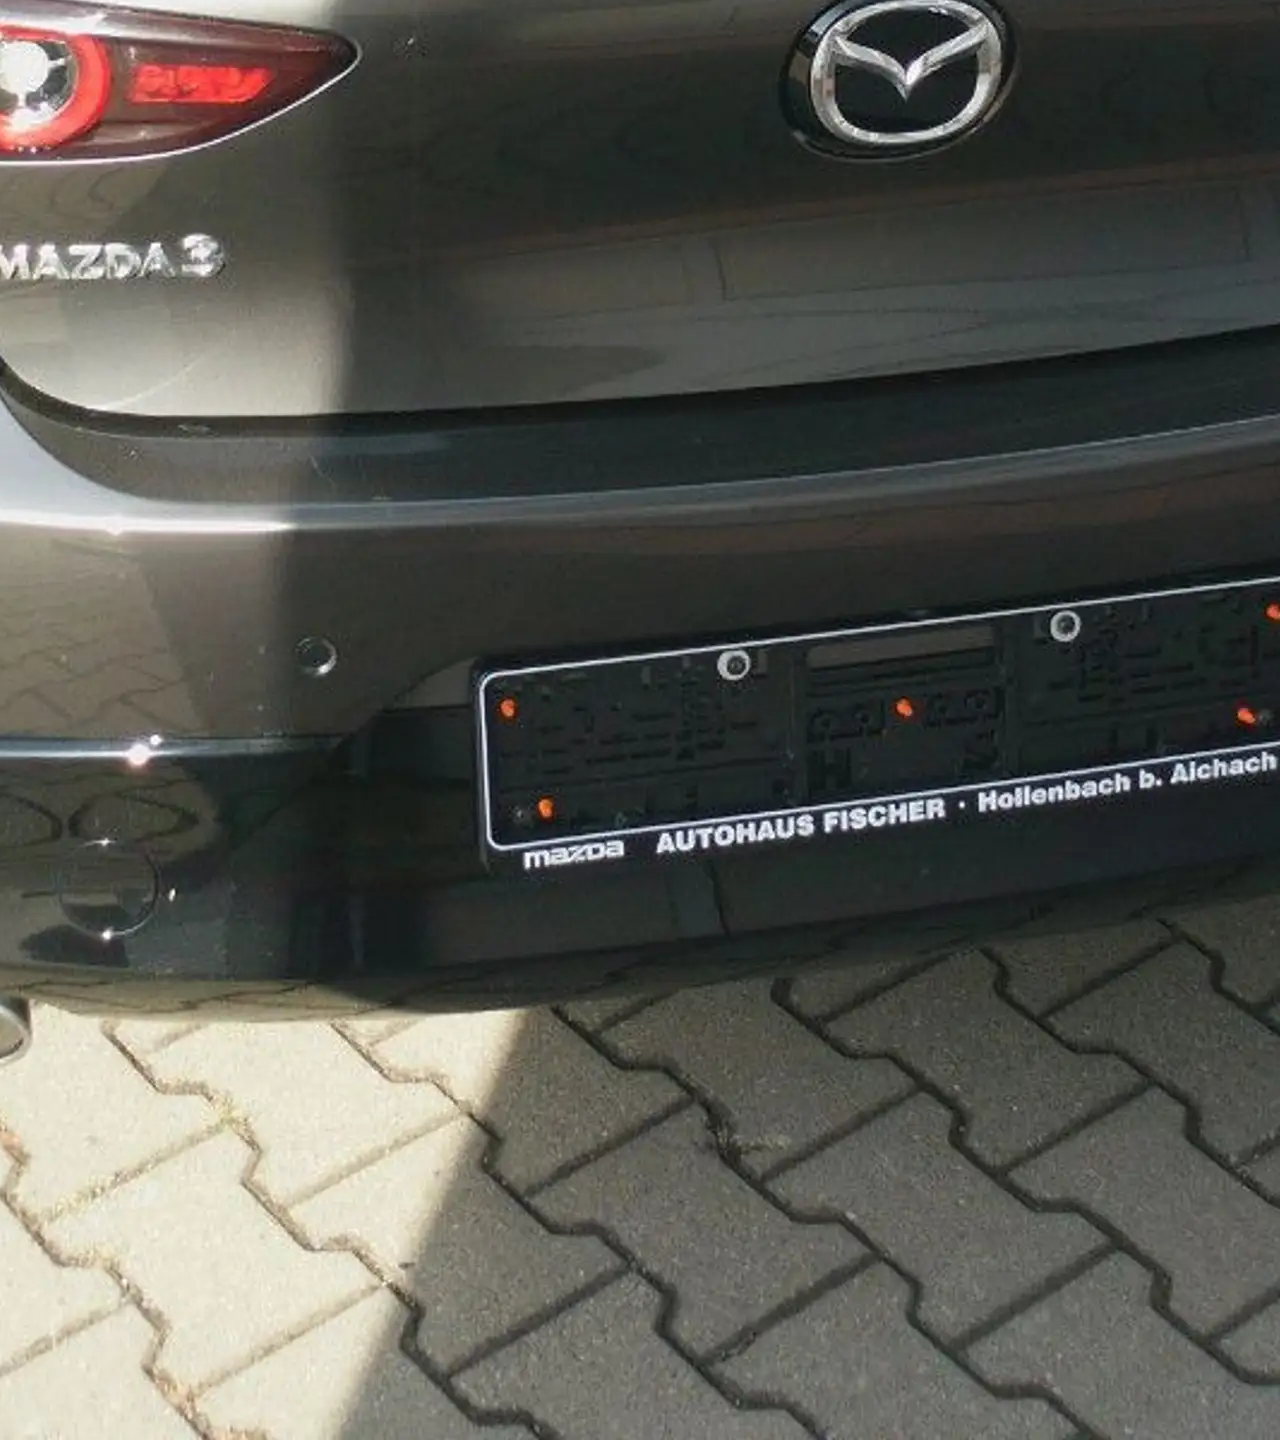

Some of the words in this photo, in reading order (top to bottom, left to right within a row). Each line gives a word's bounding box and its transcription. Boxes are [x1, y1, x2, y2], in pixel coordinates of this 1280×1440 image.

[523, 840, 625, 869] mazda
[656, 814, 815, 854] AUTOHAUS
[824, 798, 945, 835] FISCHER
[978, 772, 1131, 813] Hollenbach
[1138, 769, 1162, 789] b.
[1171, 751, 1277, 784] Aichach
